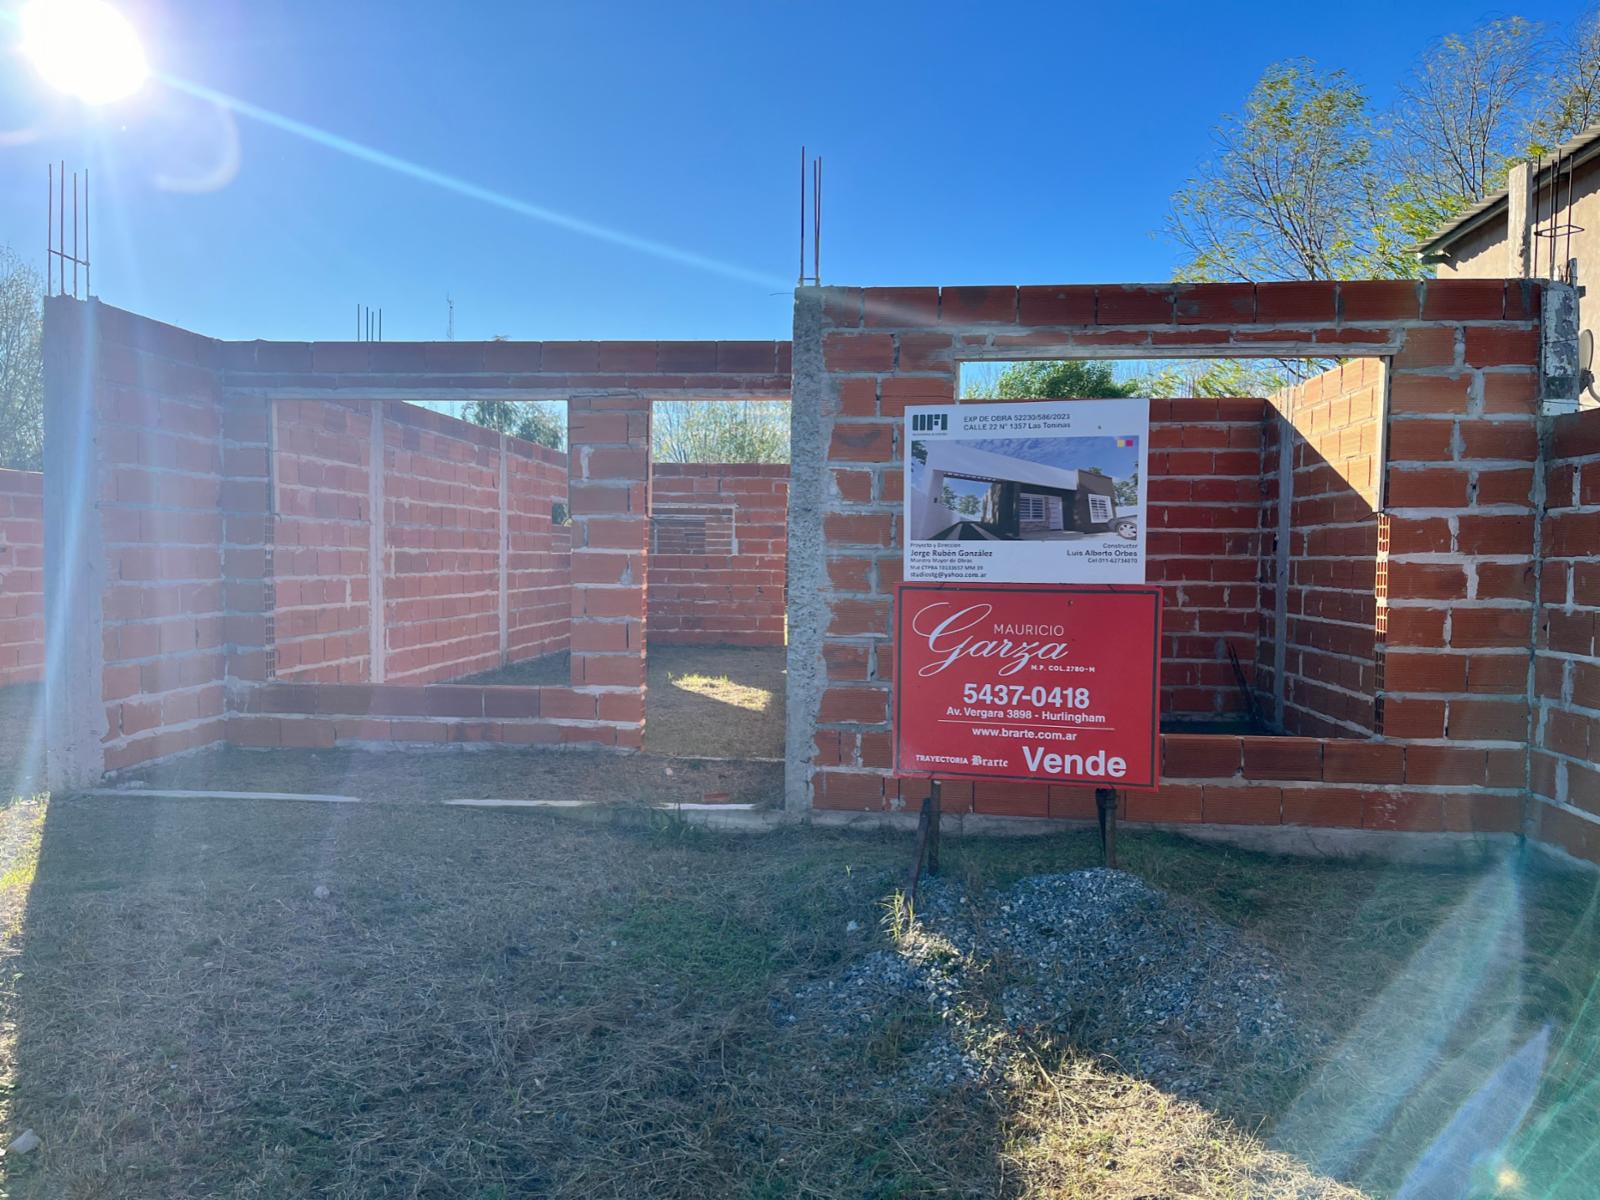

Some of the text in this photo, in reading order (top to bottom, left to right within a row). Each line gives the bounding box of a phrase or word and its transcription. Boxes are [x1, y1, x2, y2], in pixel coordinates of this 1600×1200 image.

[963, 415, 977, 423] EXP
[990, 414, 1012, 422] OBRA
[910, 549, 993, 558] Jorge Rubén González
[1084, 549, 1112, 557] Alberto
[1114, 549, 1138, 557] Orbes
[993, 624, 1065, 637] MAURICIO
[912, 602, 1069, 677] Garza
[963, 683, 1090, 709] 5437-0418
[946, 706, 962, 717] Av.
[963, 707, 1004, 719] Vergara
[1006, 709, 1032, 720] 3898
[1042, 711, 1106, 724] Hurlingham
[972, 727, 1077, 741] www.brarte.com.ar
[915, 754, 1009, 768] TRAYECTORIA Brarte
[1022, 746, 1127, 777] Vende
